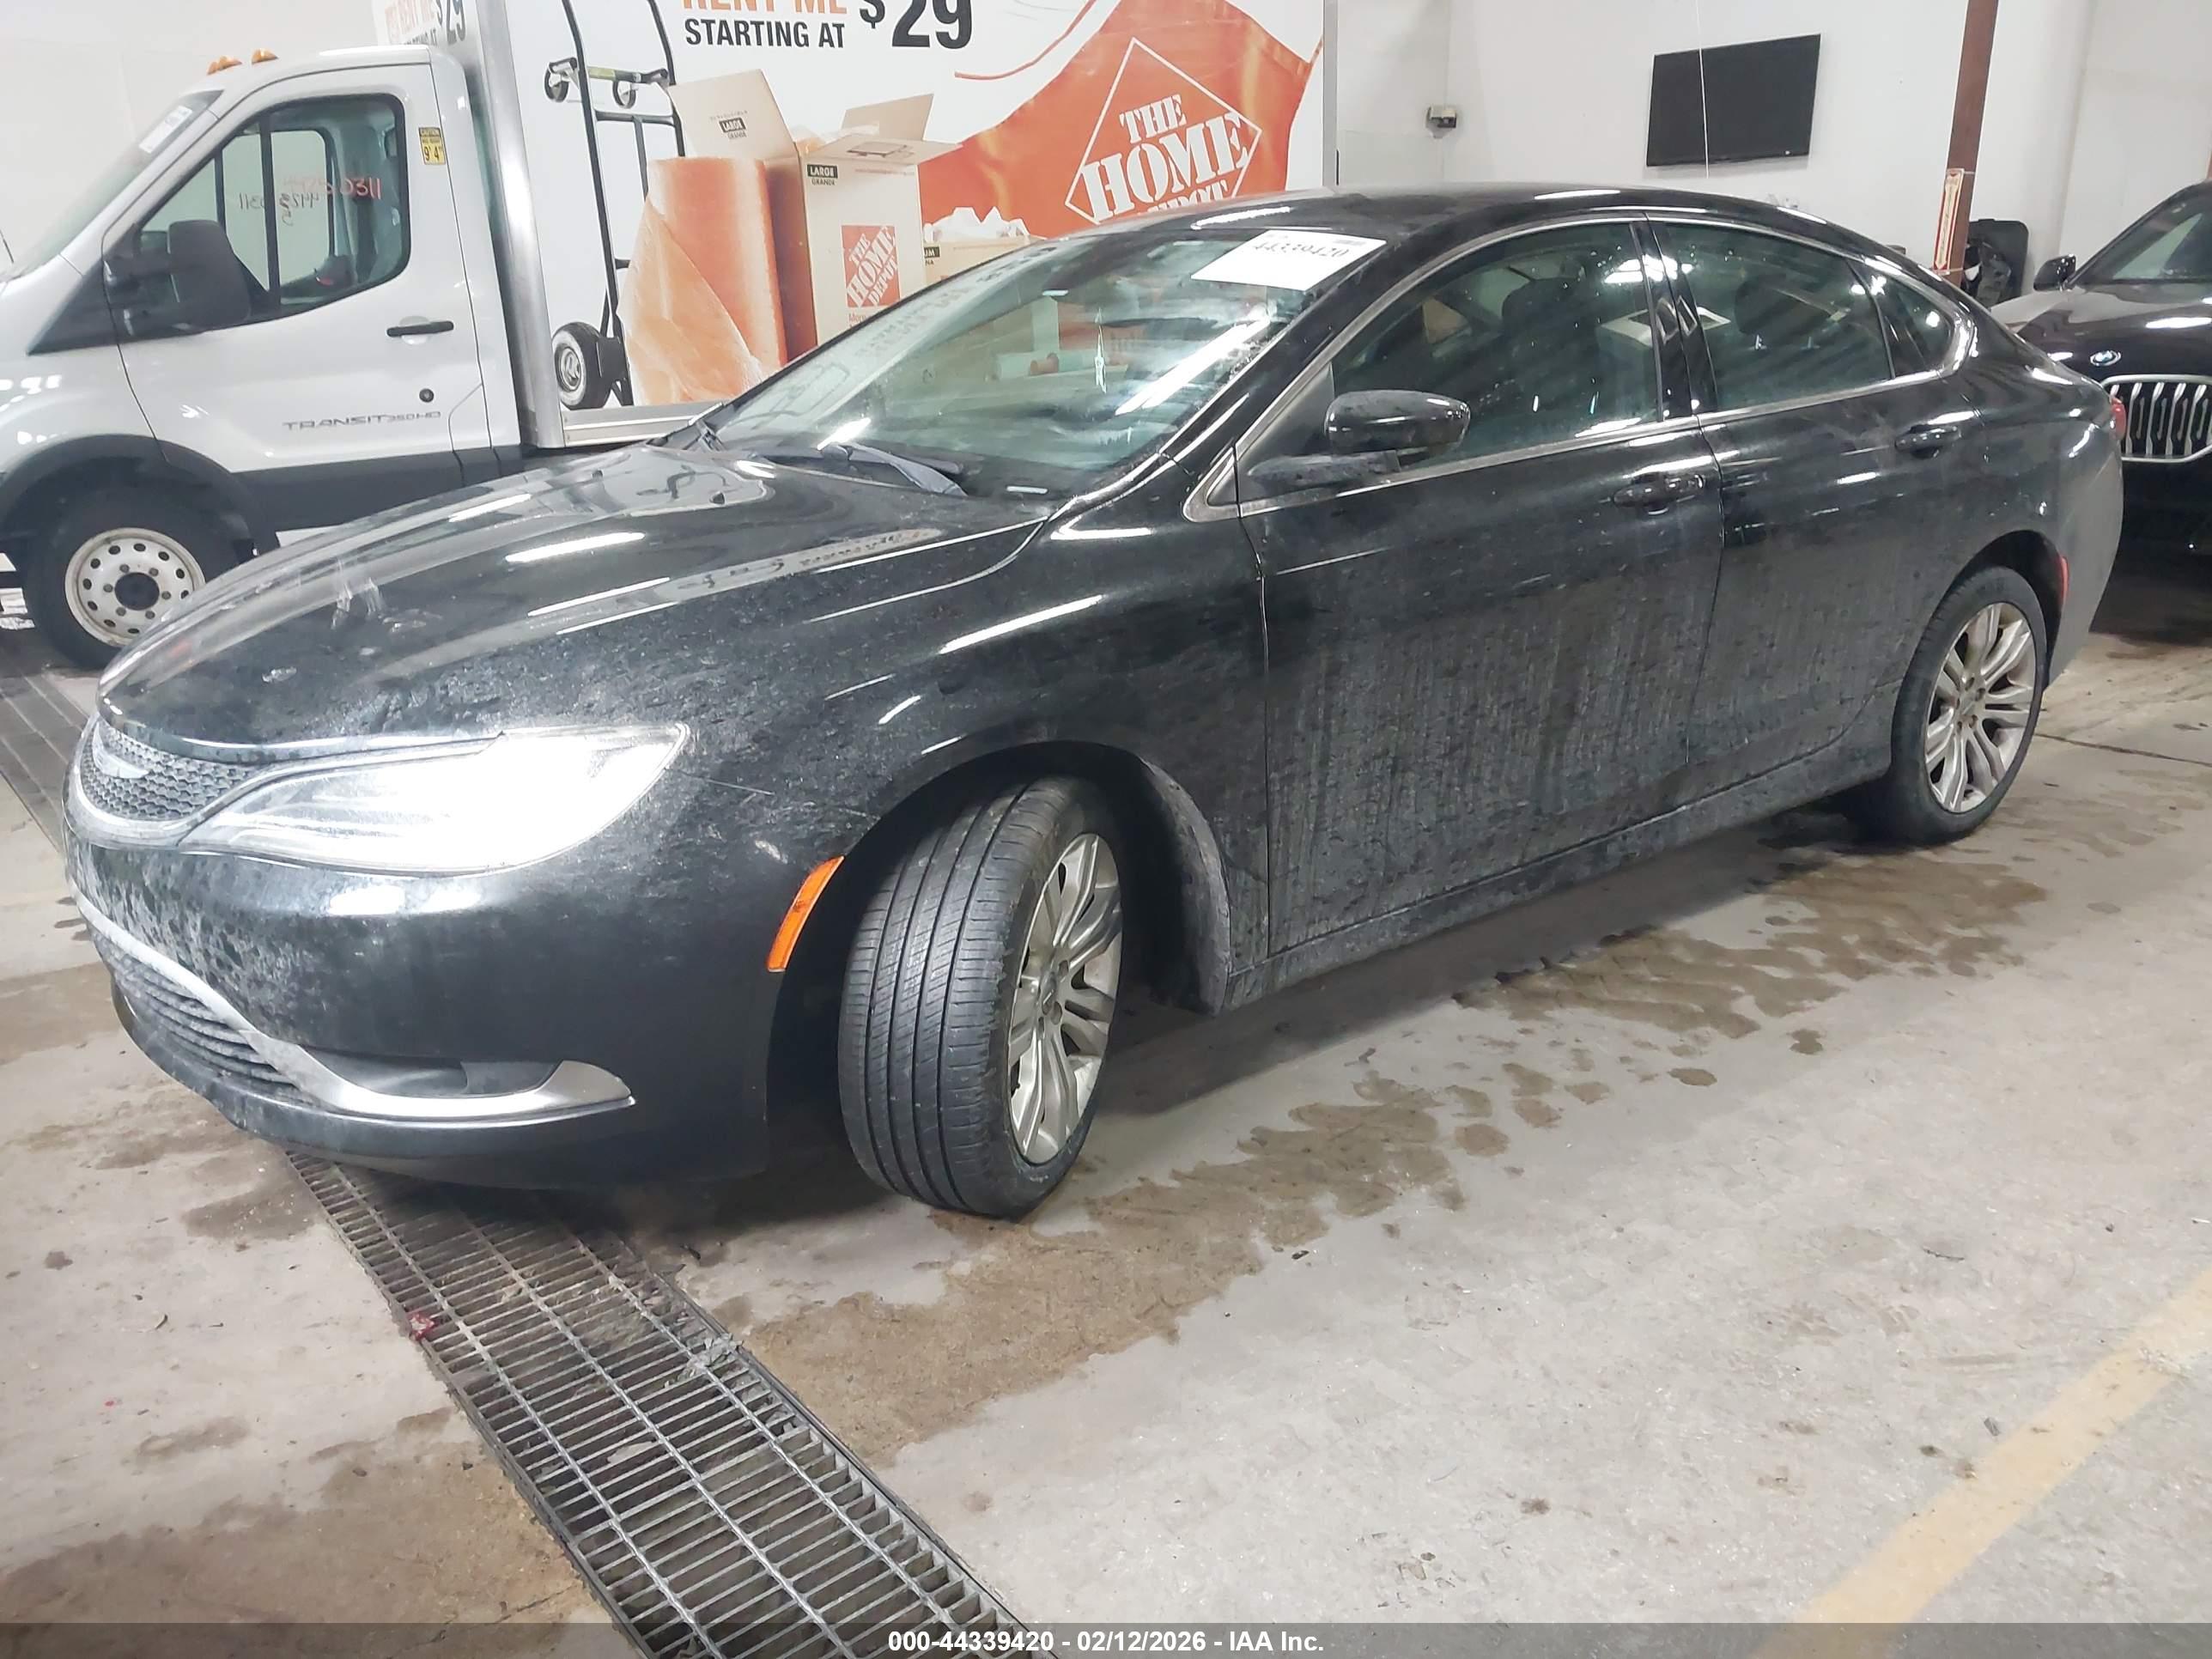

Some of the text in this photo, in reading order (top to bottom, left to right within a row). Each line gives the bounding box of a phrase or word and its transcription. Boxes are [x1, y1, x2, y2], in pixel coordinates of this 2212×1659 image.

[684, 18, 845, 48] STARTING AT
[1119, 94, 1188, 144] THE
[1079, 110, 1251, 223] HOME
[847, 226, 895, 307] HOME
[867, 256, 898, 307] DEPOT
[283, 413, 388, 431] TRANSIT
